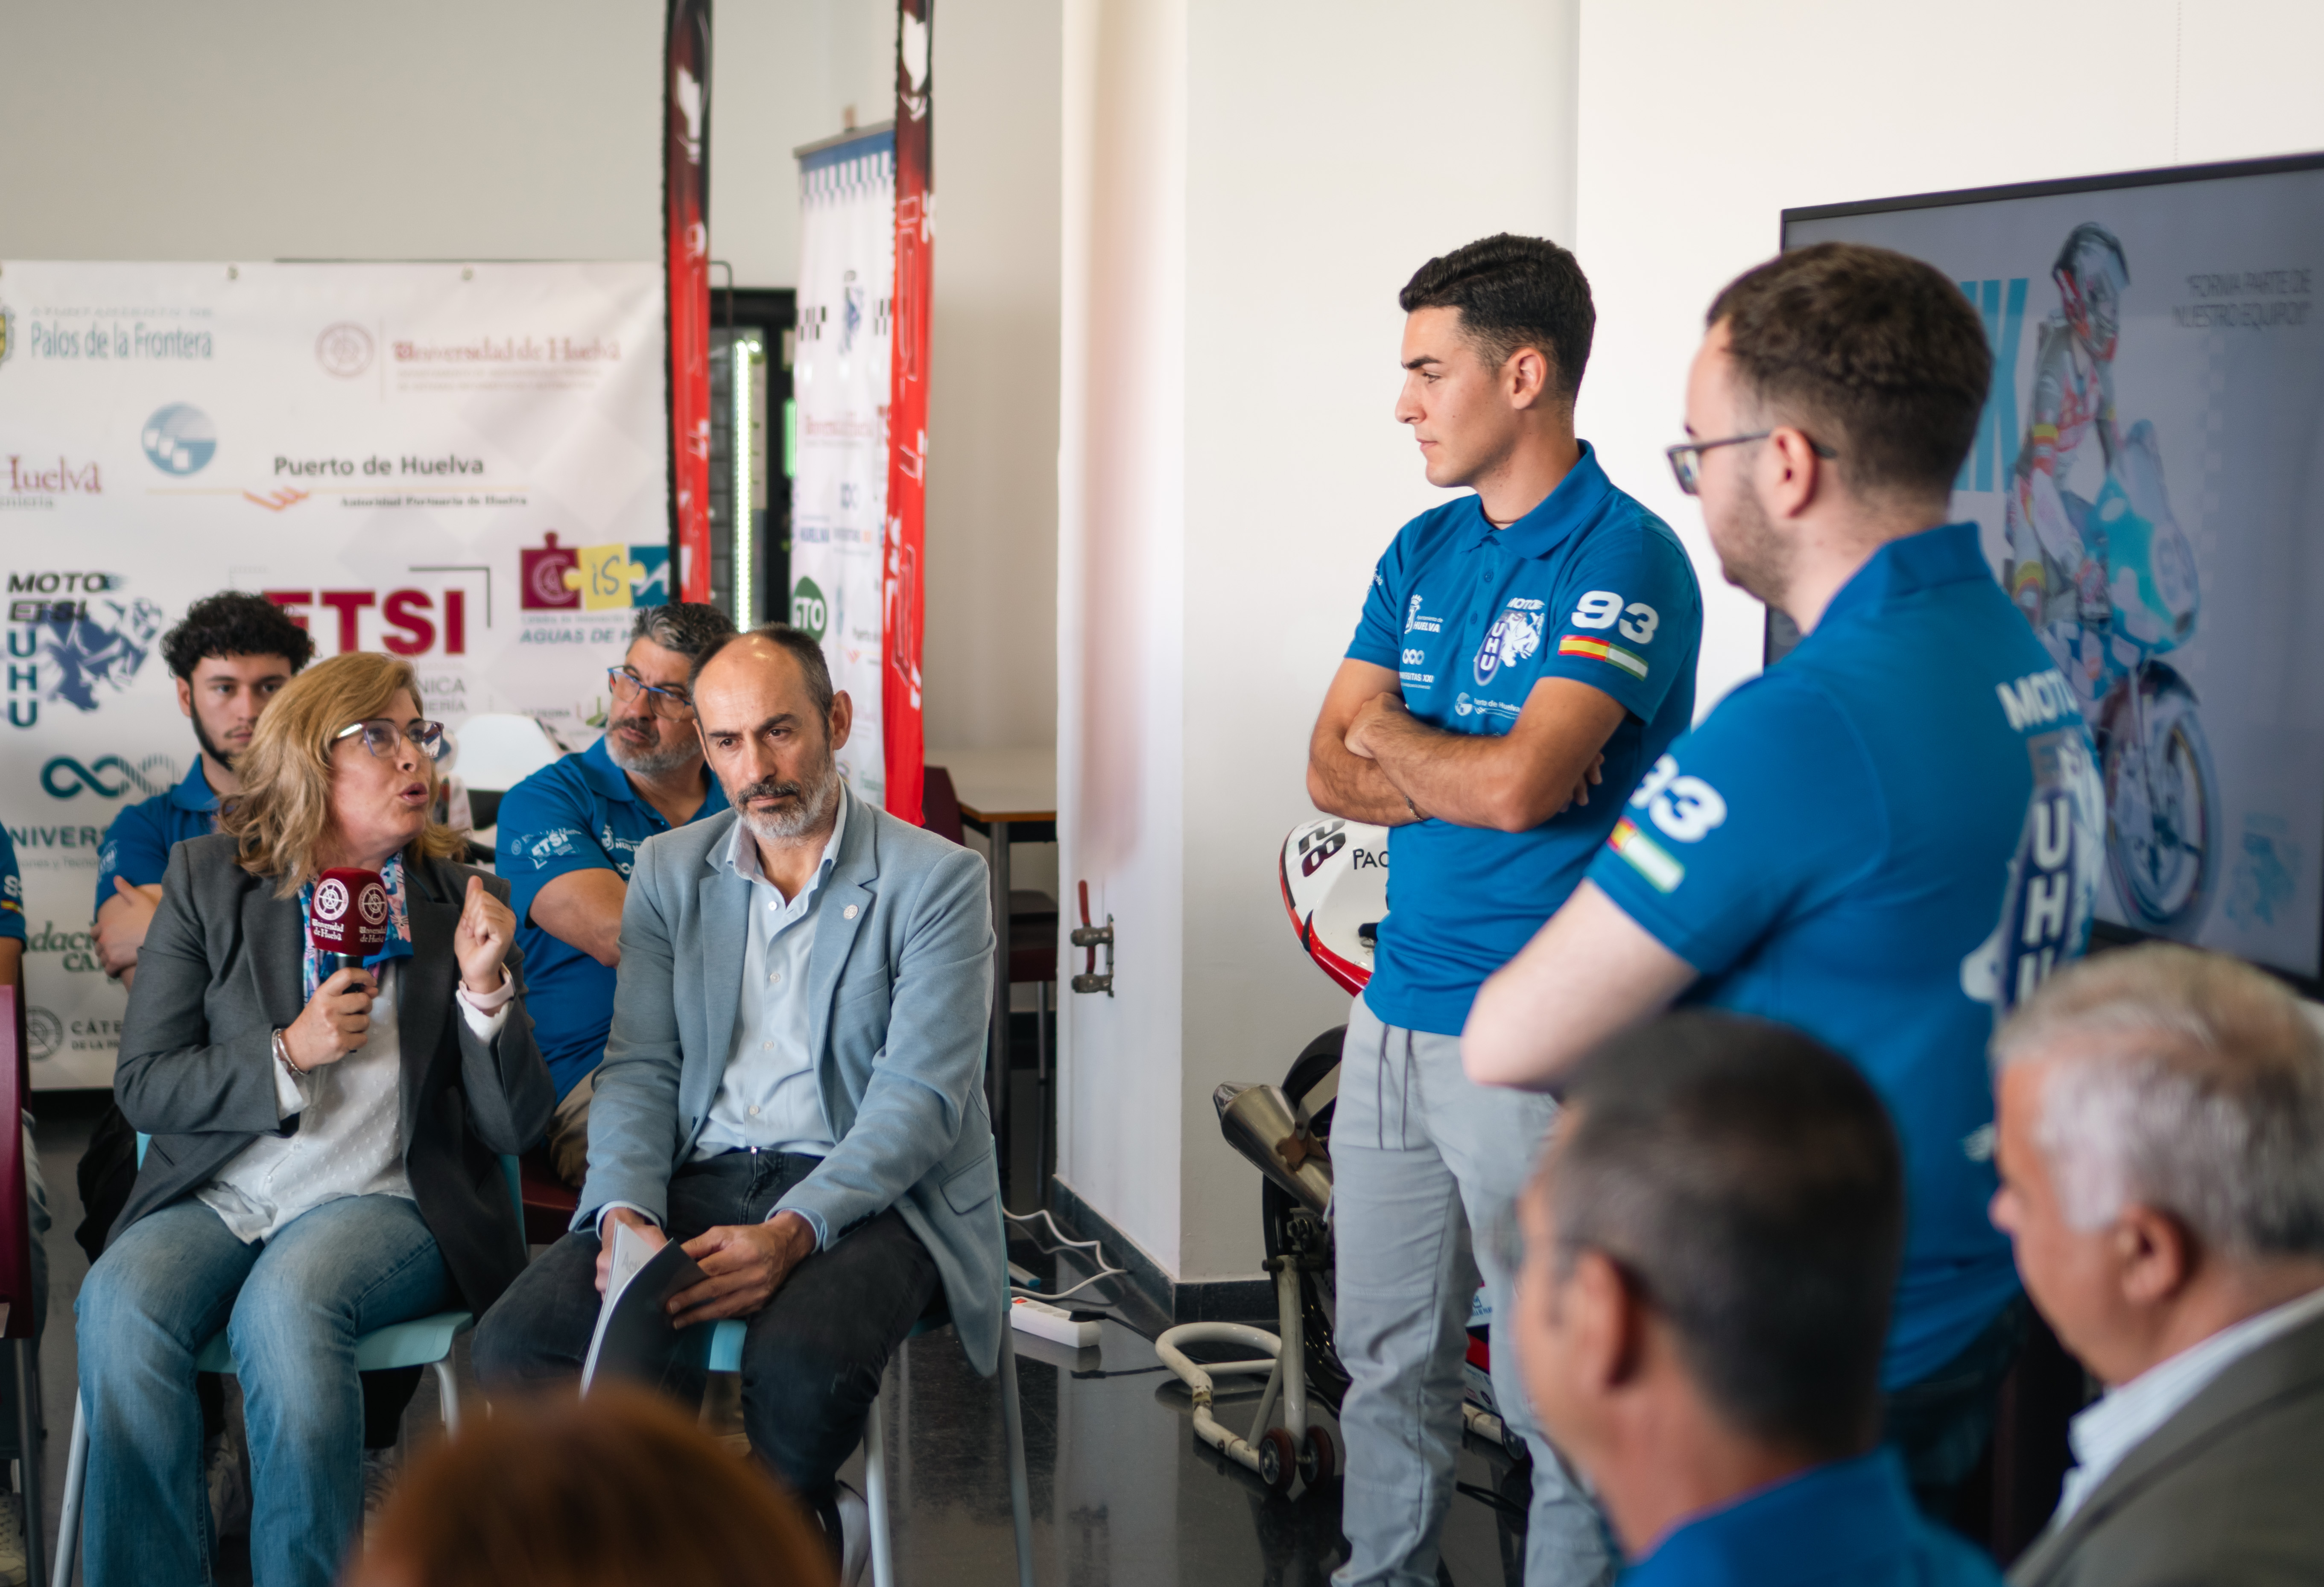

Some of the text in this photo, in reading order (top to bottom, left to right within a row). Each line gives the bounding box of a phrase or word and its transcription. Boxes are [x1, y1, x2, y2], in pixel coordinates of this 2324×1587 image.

[31, 320, 212, 359] Palos de la Frontera
[275, 454, 484, 476] Puerto de Huelva
[7, 572, 109, 593] MOTO
[9, 600, 87, 621] ETSI
[1506, 597, 1545, 610] MOTO
[1571, 590, 1660, 644] 93
[1413, 621, 1441, 633] HUELVA
[520, 629, 584, 644] AGUAS
[591, 629, 615, 643] DE
[1422, 674, 1434, 683] XXI
[1499, 701, 1520, 712] Huelva
[531, 833, 569, 856] ETSI
[312, 918, 344, 932] Universidad
[313, 927, 342, 941] de Huelva
[360, 934, 368, 942] de
